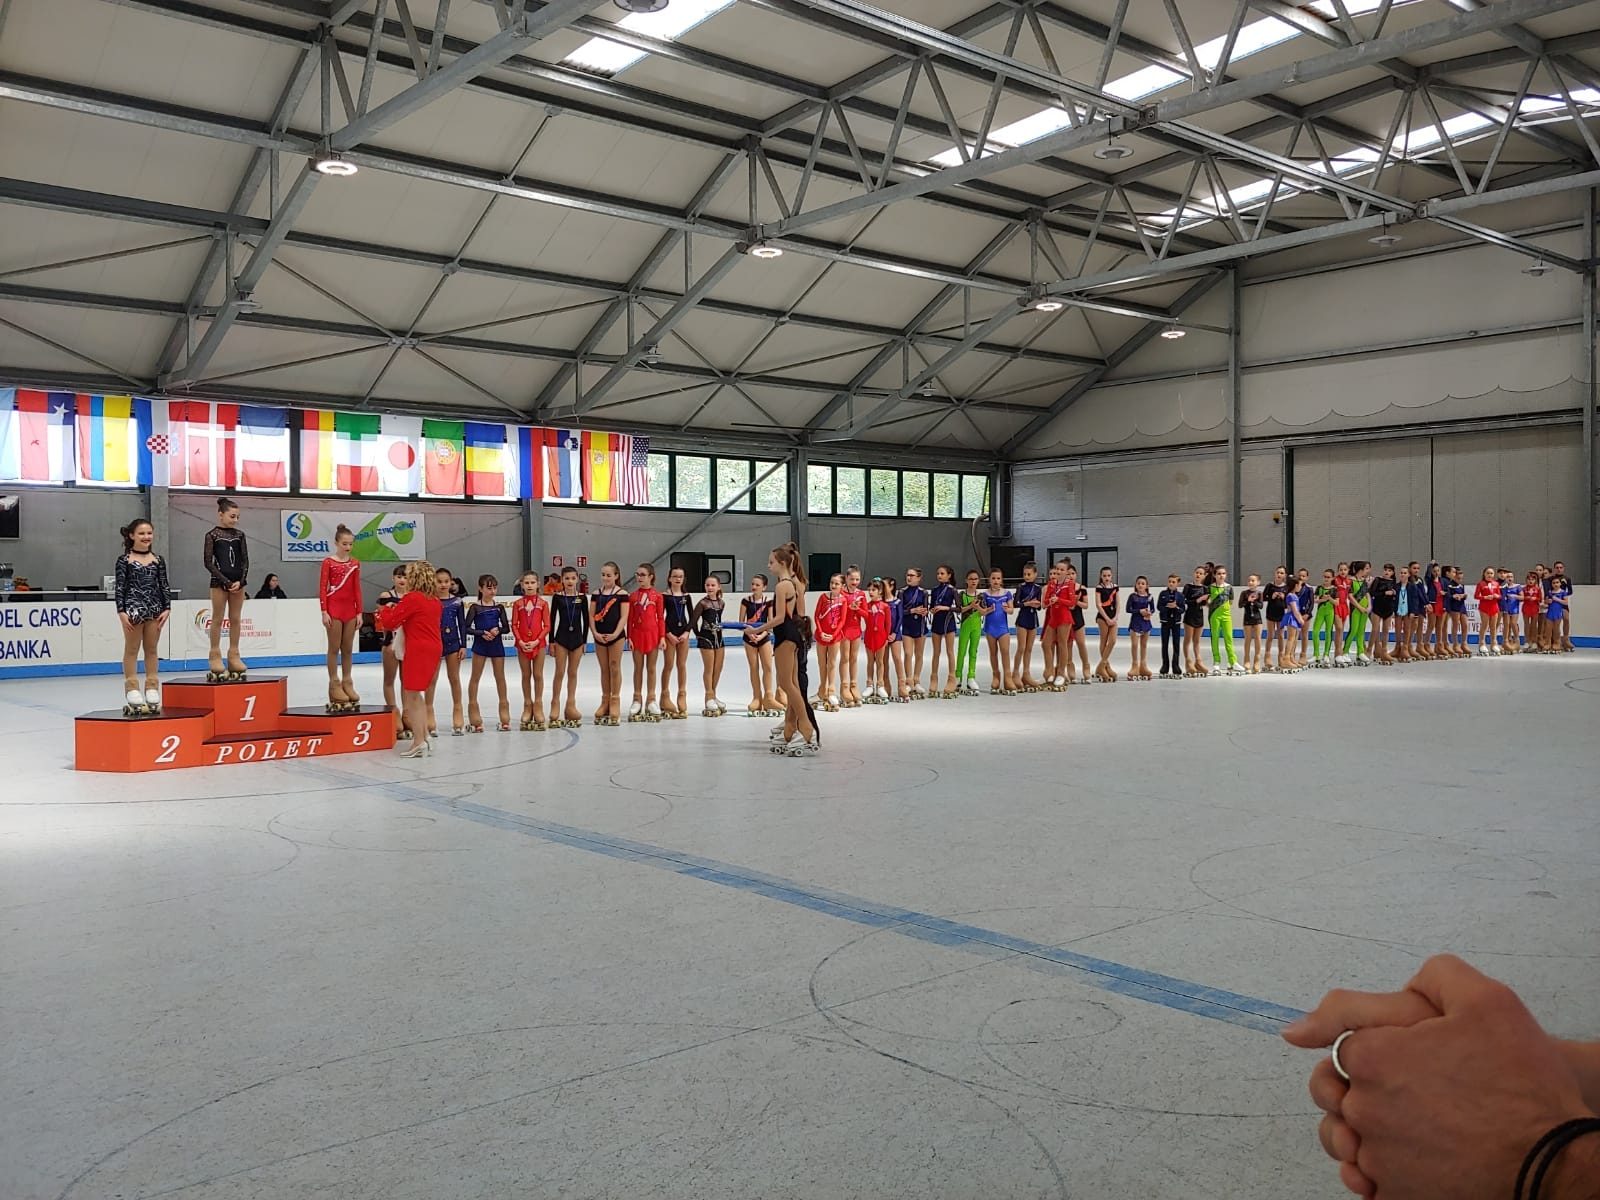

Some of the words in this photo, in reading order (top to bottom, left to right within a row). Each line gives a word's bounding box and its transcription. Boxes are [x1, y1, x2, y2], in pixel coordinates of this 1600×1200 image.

[239, 695, 257, 721] 1
[352, 720, 372, 746] 3
[154, 735, 181, 763] 2
[214, 738, 323, 764] POLET
